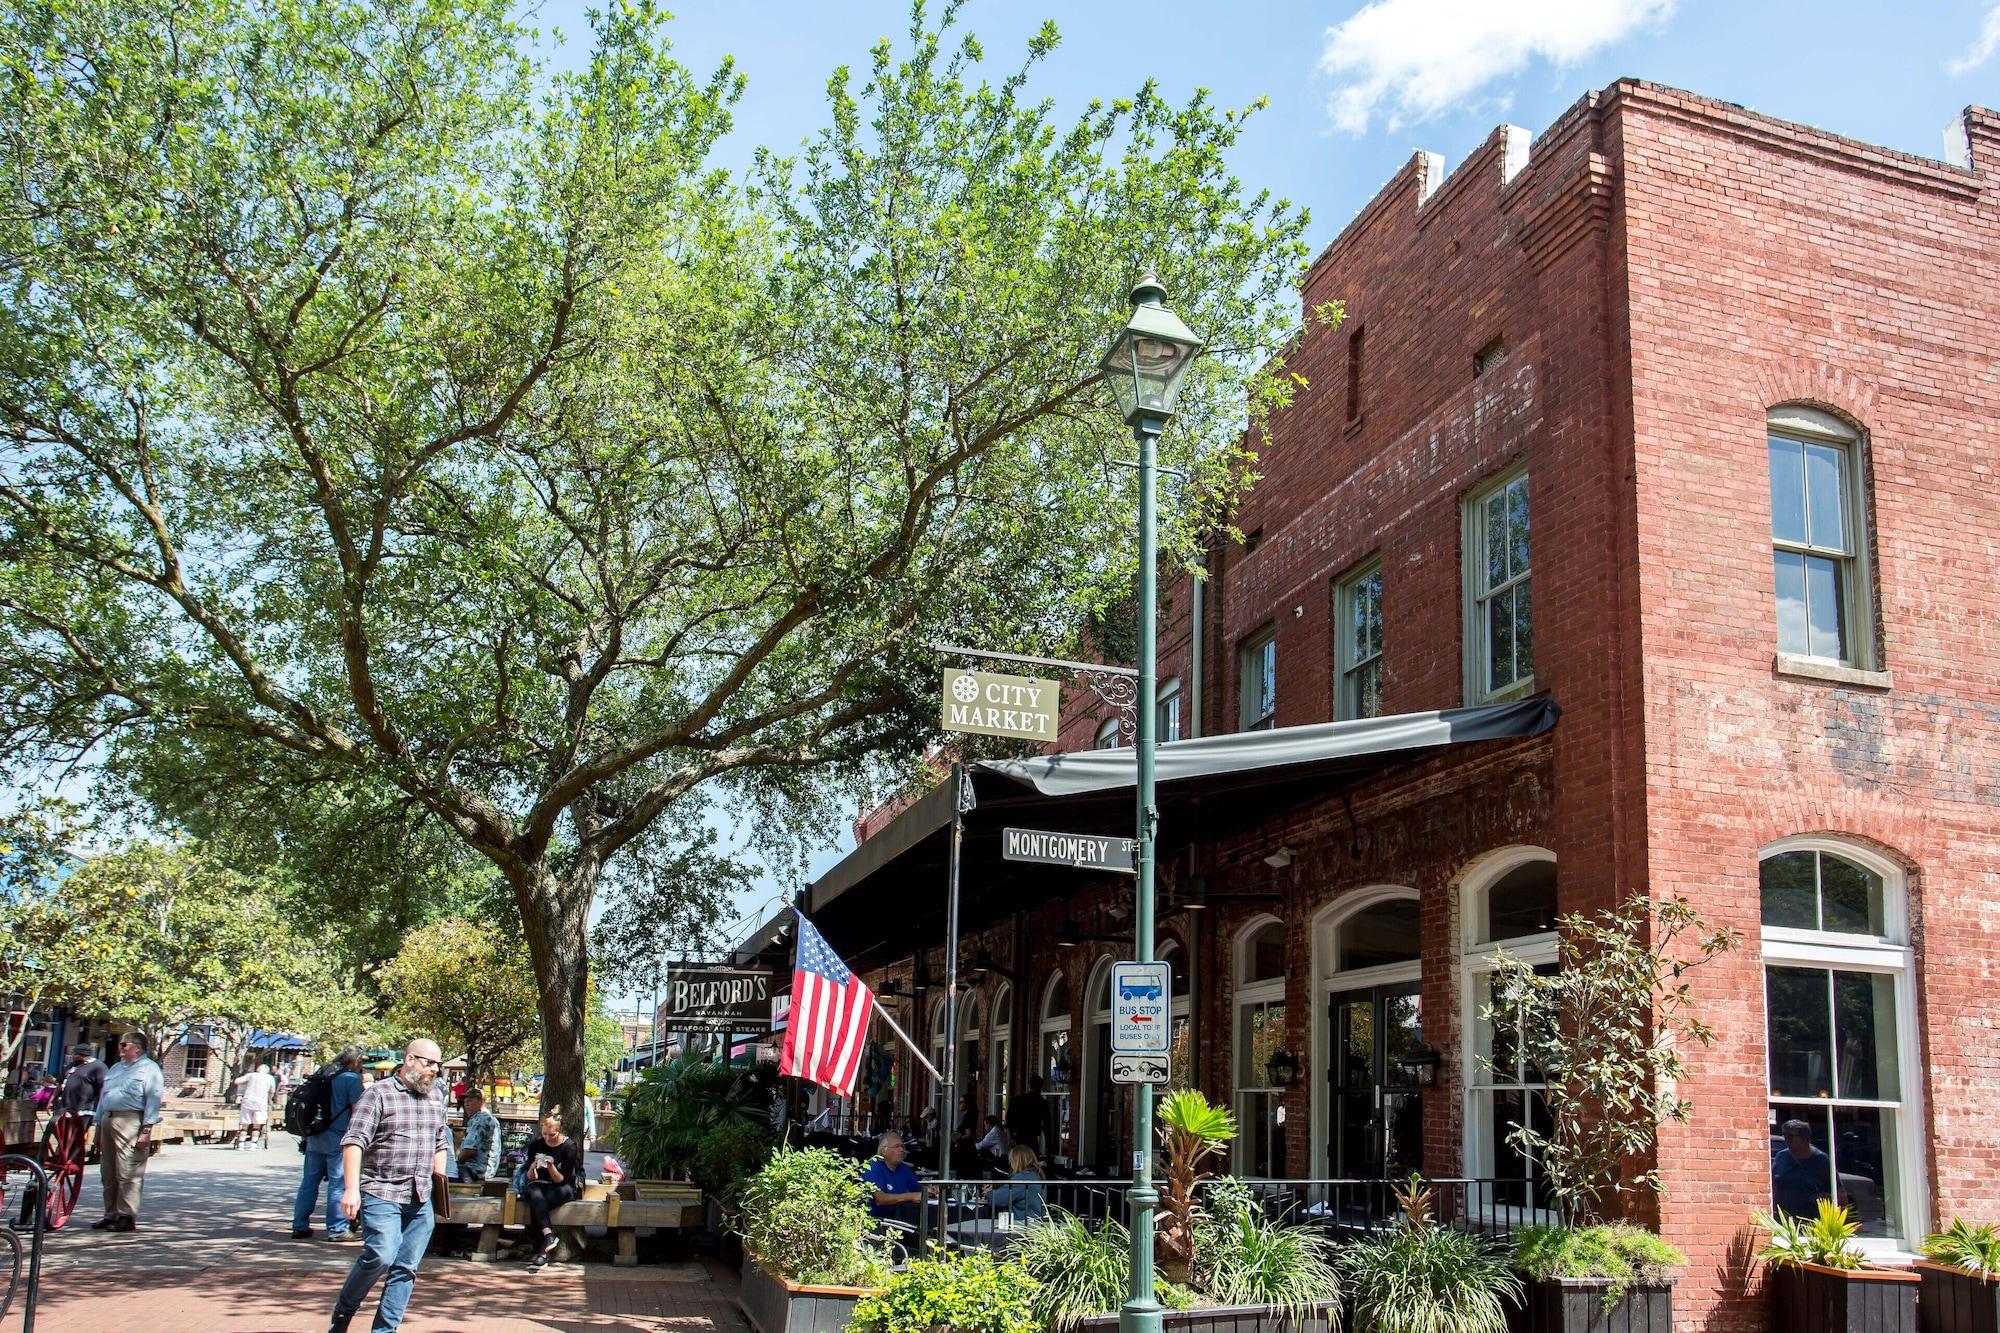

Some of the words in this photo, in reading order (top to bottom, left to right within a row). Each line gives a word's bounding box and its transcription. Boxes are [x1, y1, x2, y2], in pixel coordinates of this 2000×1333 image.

[986, 683, 1042, 708] CITY
[949, 704, 1050, 733] MARKET
[1009, 832, 1108, 863] MONTGOMERY
[1121, 840, 1132, 852] ST
[673, 975, 766, 1014] BELFORD'S
[1120, 1006, 1137, 1015] BUS
[1139, 1006, 1162, 1015] STOP
